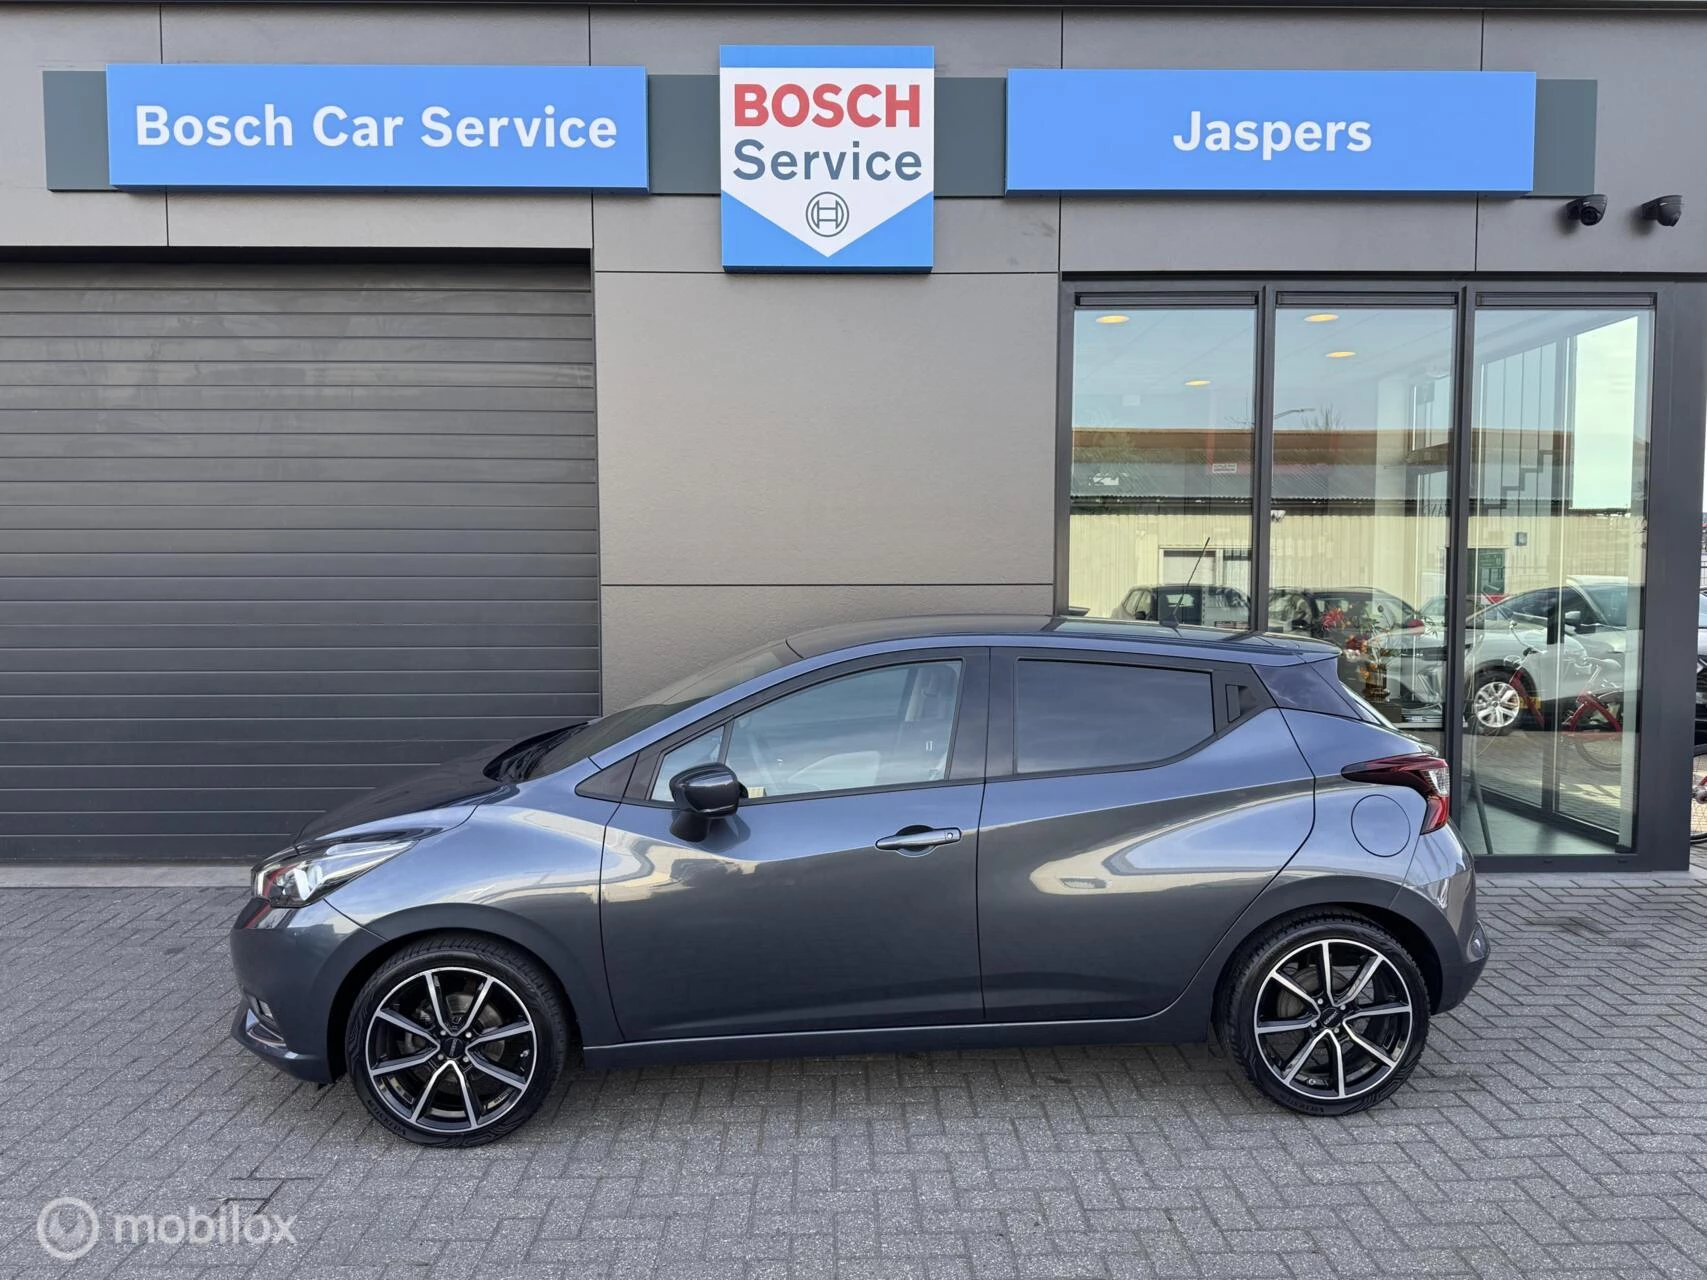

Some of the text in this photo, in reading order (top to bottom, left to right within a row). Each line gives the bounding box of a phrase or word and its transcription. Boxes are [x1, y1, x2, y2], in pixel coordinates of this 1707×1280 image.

[136, 103, 617, 149] Bosch Car Service
[733, 83, 921, 128] BOSCH
[1173, 111, 1372, 161] Jaspers
[733, 138, 922, 182] Service
